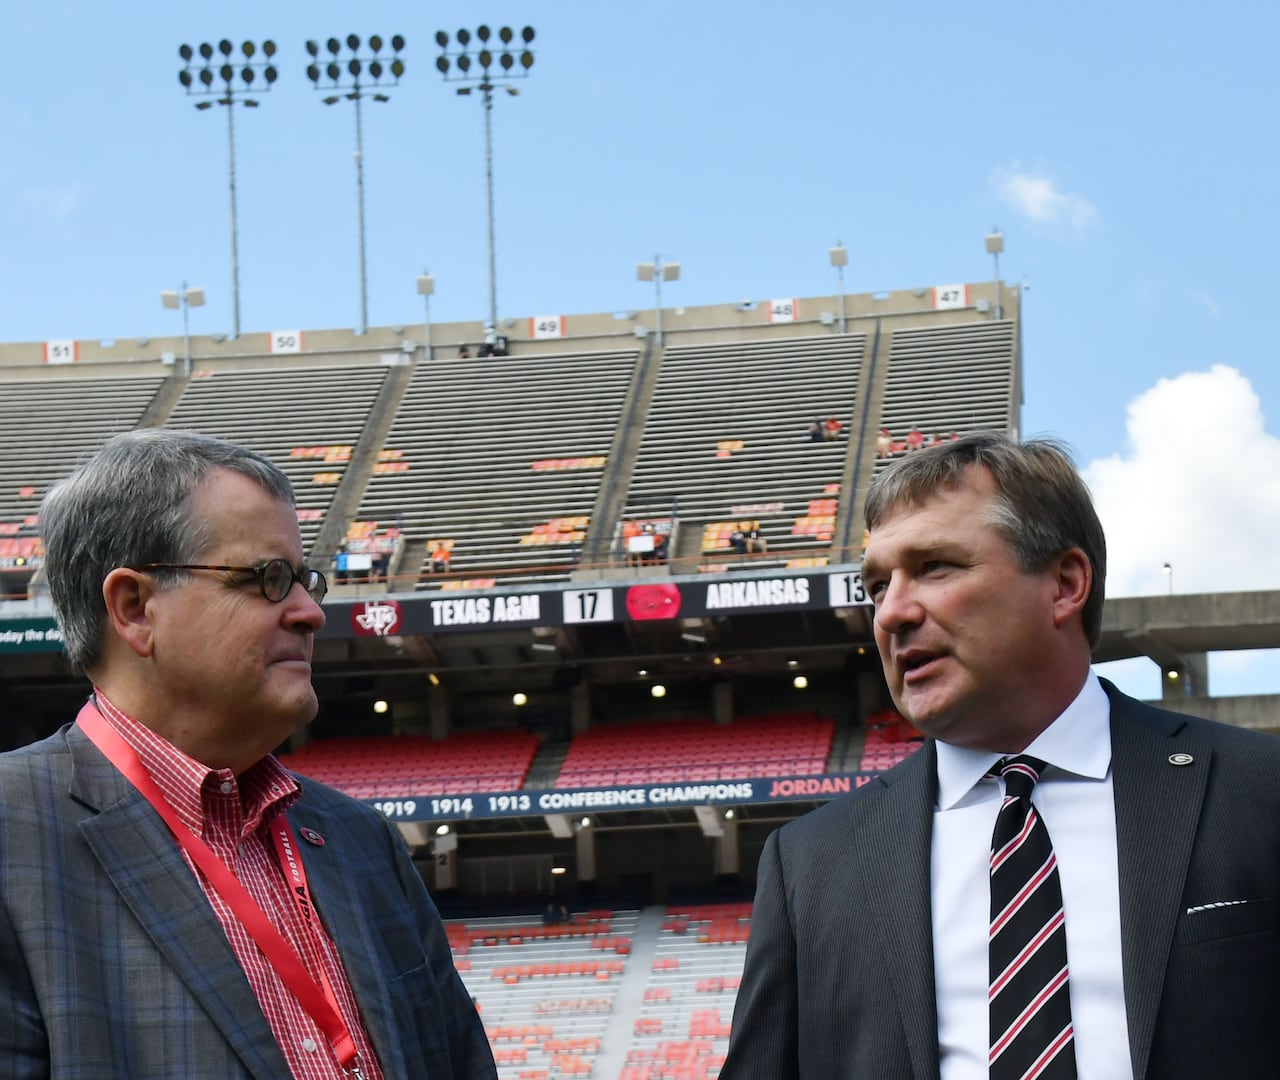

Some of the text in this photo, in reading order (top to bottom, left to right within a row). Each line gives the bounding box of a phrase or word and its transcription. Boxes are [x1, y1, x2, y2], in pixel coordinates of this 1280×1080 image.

[940, 290, 960, 302] 47
[538, 320, 557, 332] 49
[276, 335, 295, 348] 50
[706, 574, 866, 609] ARKANSAS 13
[431, 592, 599, 626] TEXAS A&M 17
[25, 628, 43, 641] the
[769, 776, 850, 797] JORDAN
[432, 798, 474, 815] 1914
[488, 795, 531, 812] 1913
[539, 788, 646, 809] CONFERENCE
[648, 783, 753, 802] CHAMPIONS
[280, 830, 301, 882] FOOTBALL
